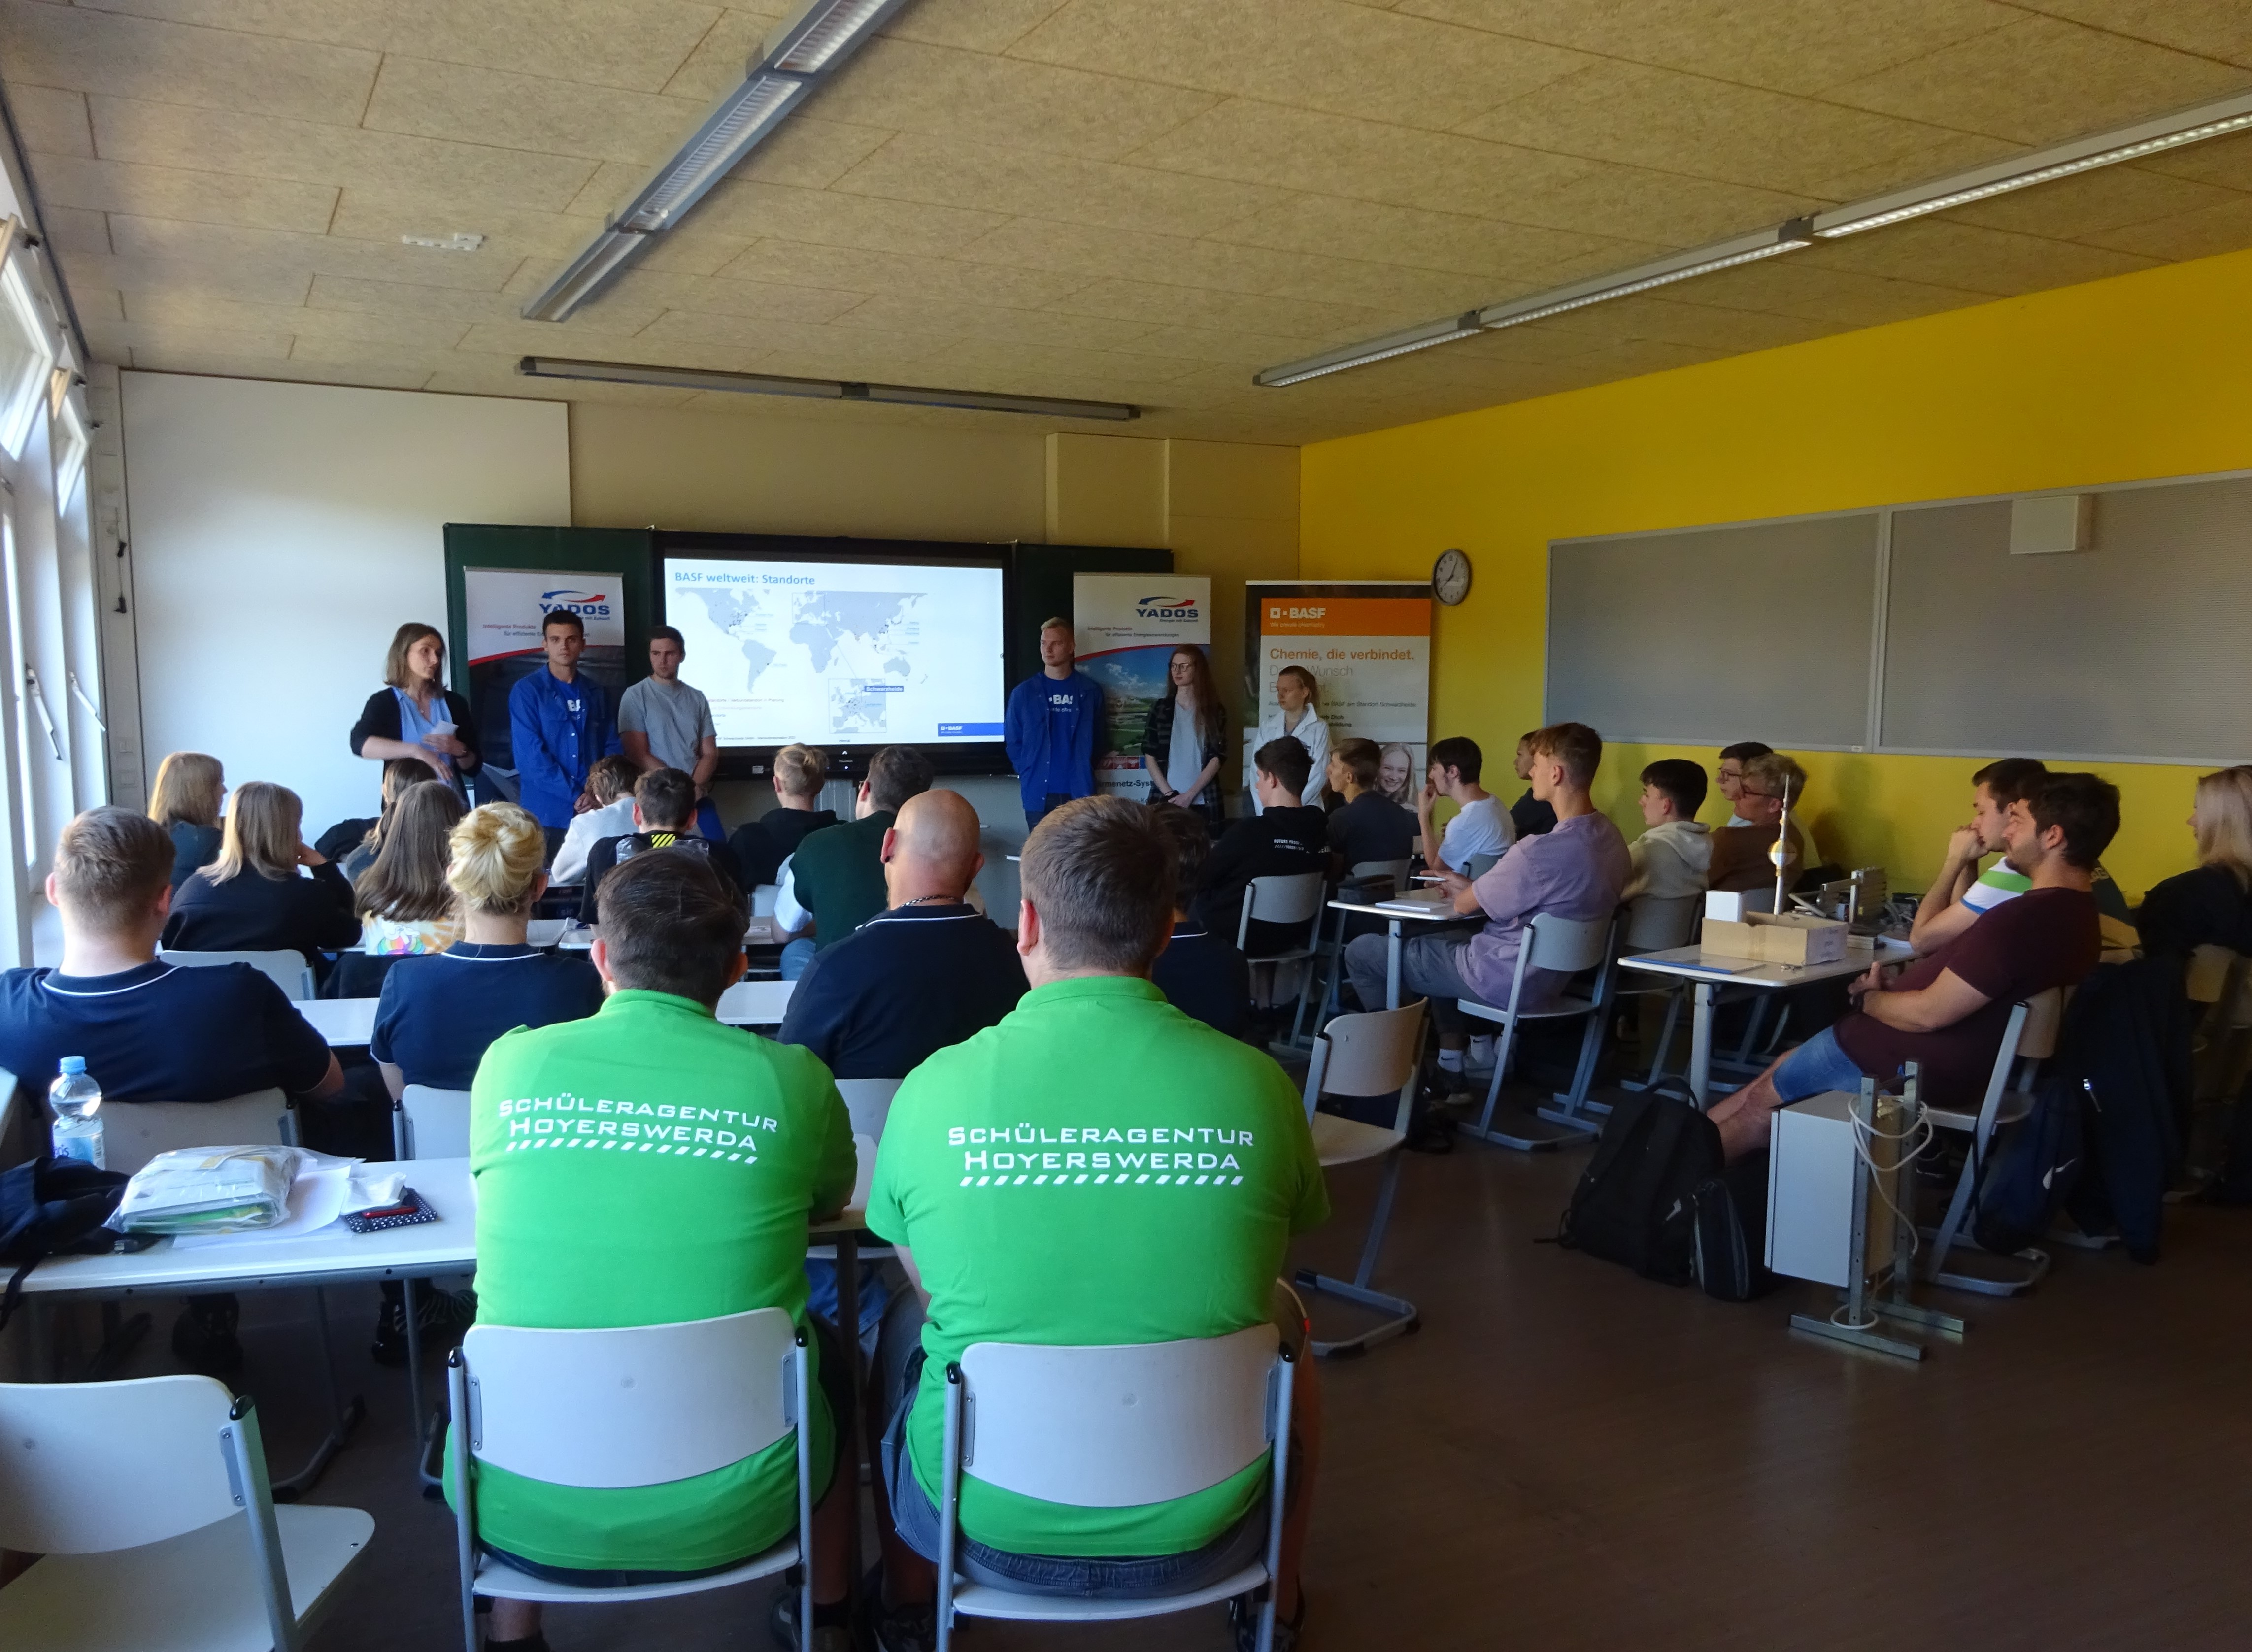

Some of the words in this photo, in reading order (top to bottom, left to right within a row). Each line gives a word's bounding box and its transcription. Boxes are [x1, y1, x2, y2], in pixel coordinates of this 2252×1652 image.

[675, 572, 703, 582] BASF
[706, 573, 758, 584] weltweit:
[762, 574, 815, 585] Standorte
[539, 603, 610, 615] YADOS
[1135, 608, 1199, 618] YADOS
[1289, 607, 1326, 619] BASF
[1270, 648, 1322, 661] Chemie,
[1326, 648, 1345, 660] die
[1350, 649, 1414, 660] verbindet.
[1307, 665, 1353, 677] Wunsch
[1053, 694, 1074, 705] BA
[499, 1092, 778, 1133] SCHÜLERAGENTUR
[510, 1117, 757, 1151] HOYERSWERDA
[948, 1122, 1254, 1147] SCHÜLERAGENTUR
[964, 1150, 1240, 1171] HOYERSWERDA
